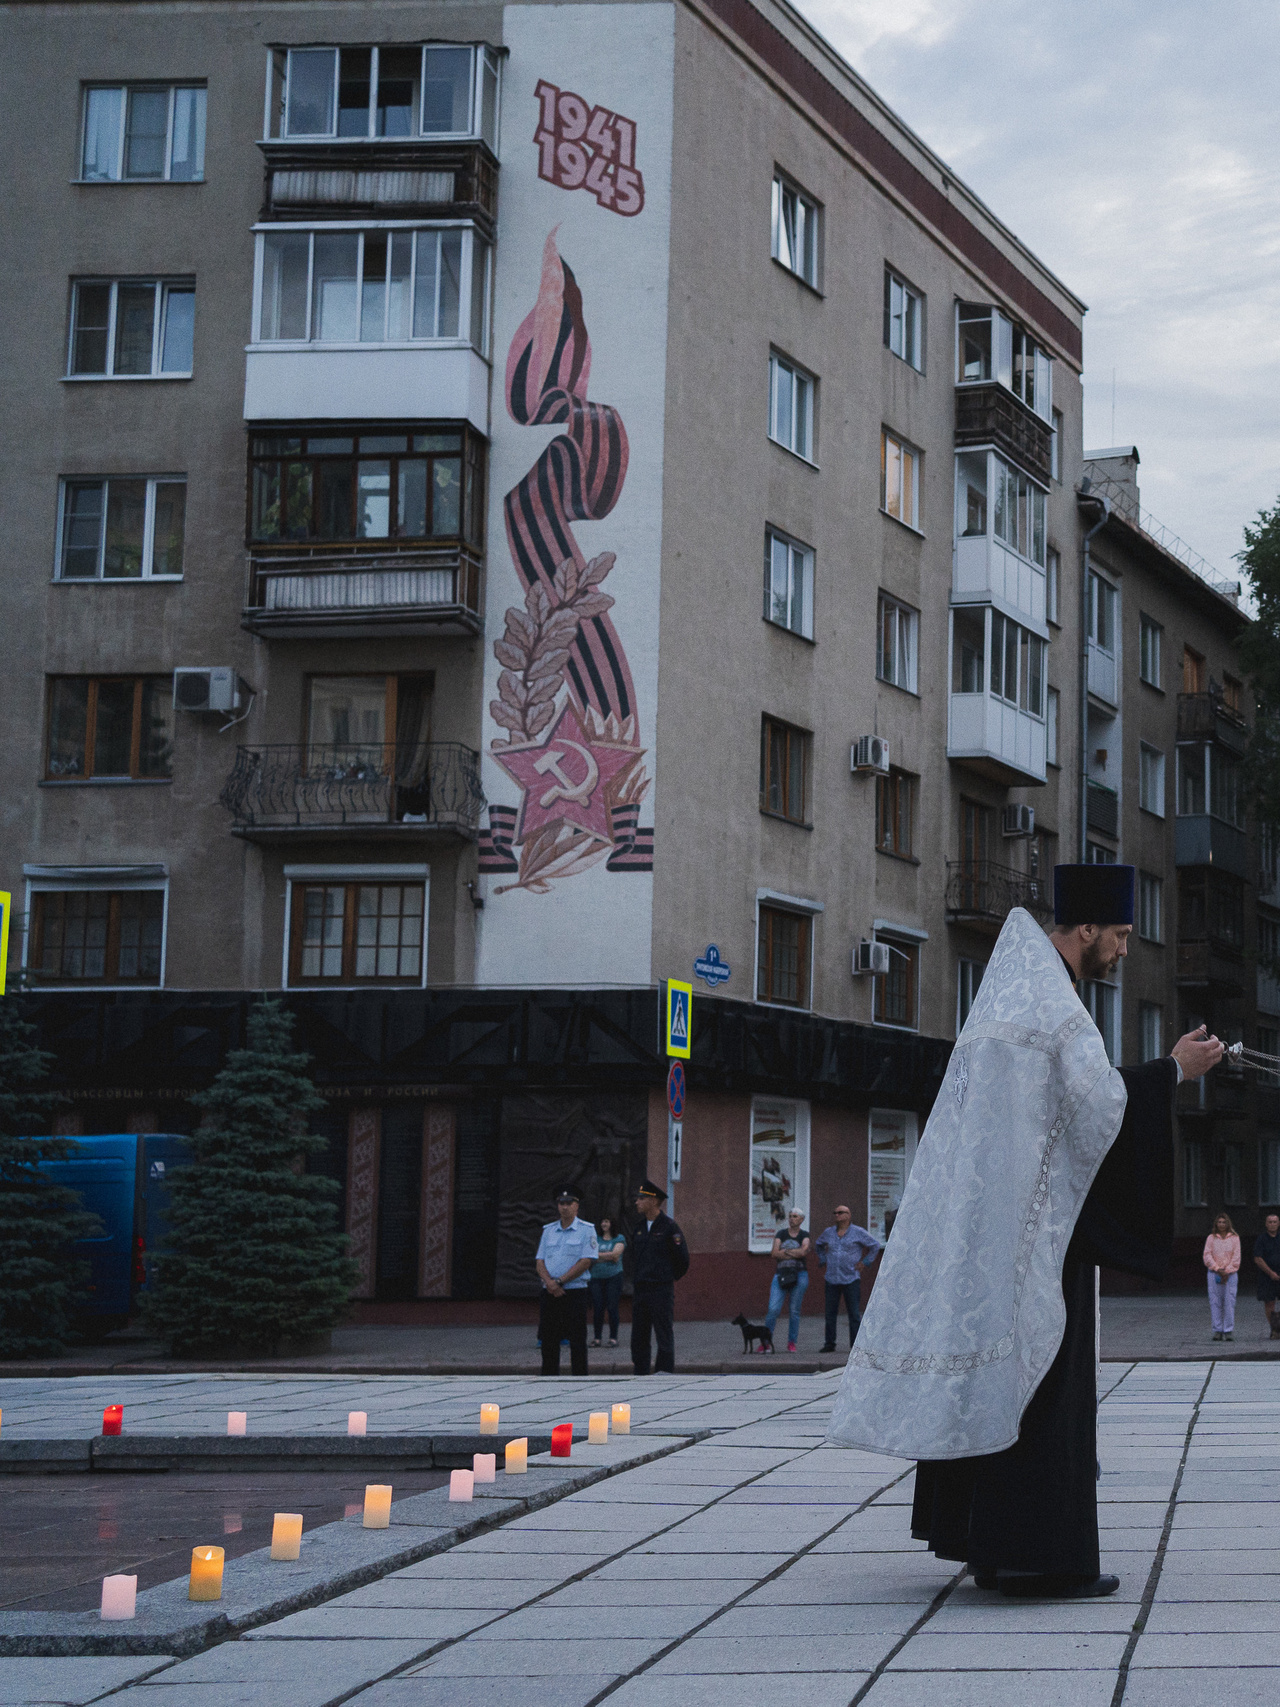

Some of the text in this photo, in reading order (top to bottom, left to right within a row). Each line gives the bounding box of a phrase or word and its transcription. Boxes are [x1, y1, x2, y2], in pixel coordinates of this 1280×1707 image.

[534, 78, 636, 168] 1941
[533, 131, 645, 217] 1945
[387, 1086, 439, 1096] РОССИИ
